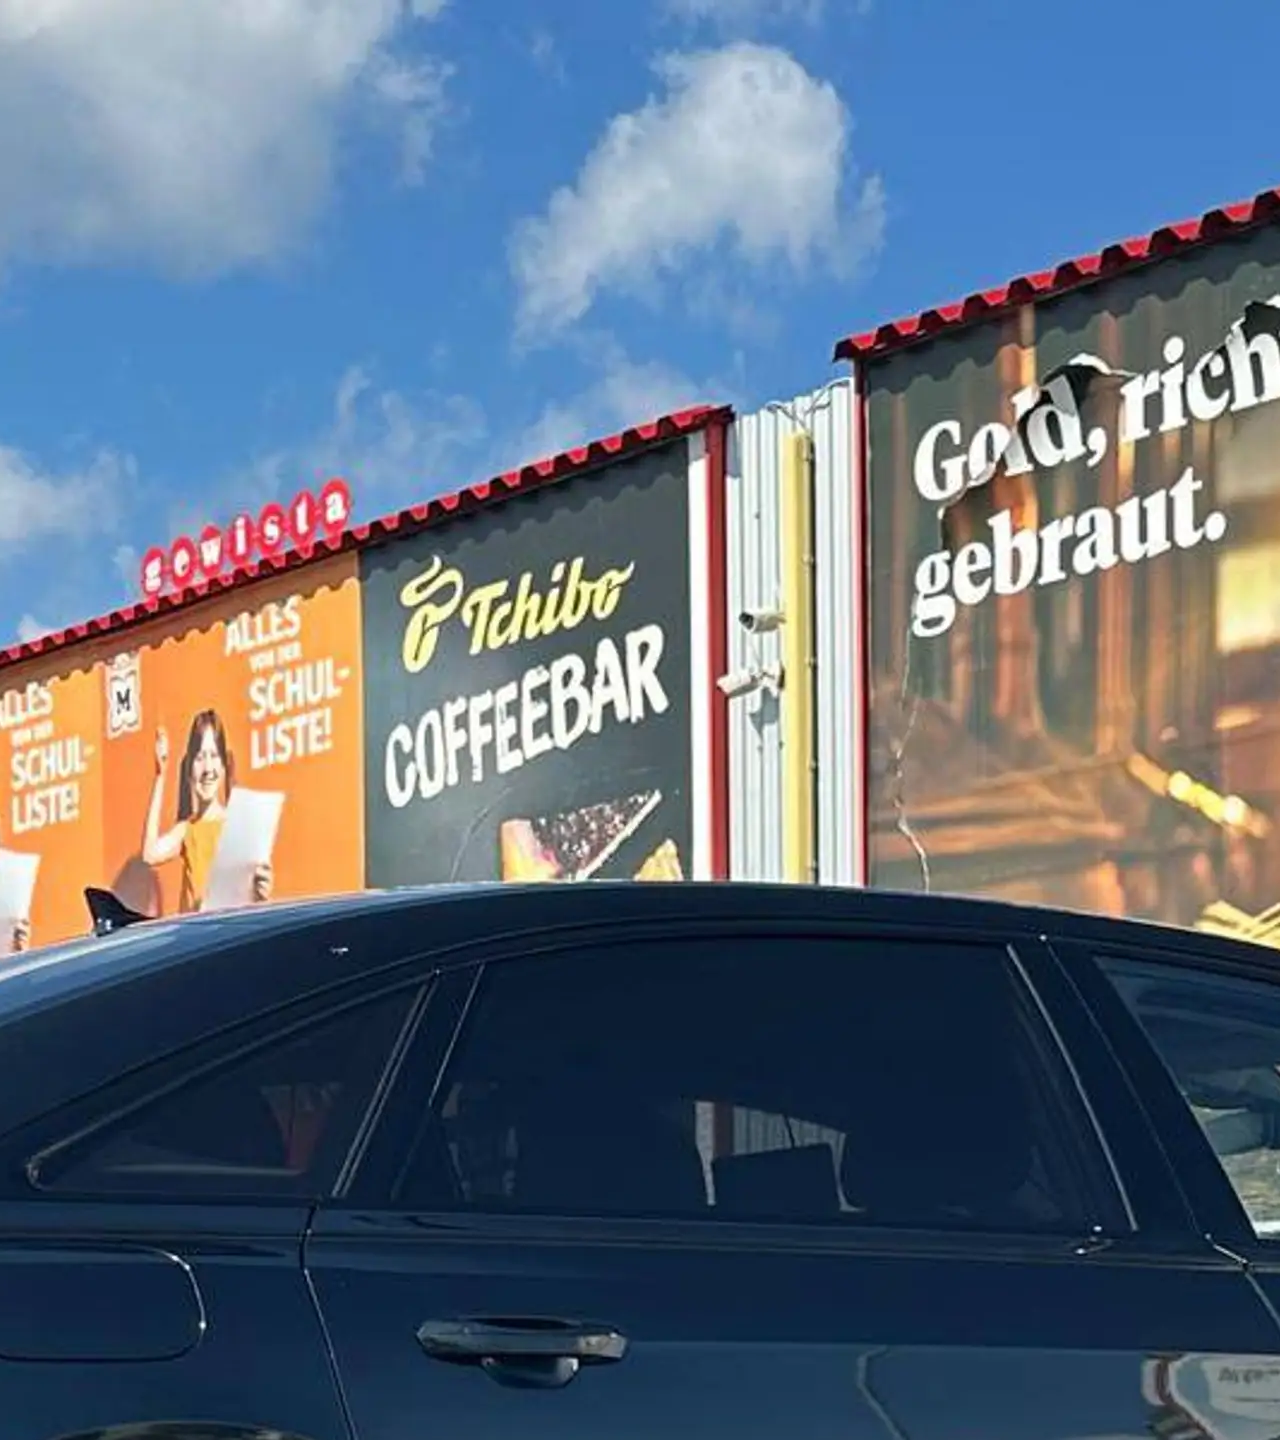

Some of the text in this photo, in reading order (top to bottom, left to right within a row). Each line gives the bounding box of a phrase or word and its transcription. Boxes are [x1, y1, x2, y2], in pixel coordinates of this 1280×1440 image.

[914, 374, 1107, 501] Gold,
[911, 466, 1228, 638] gebraut.
[225, 594, 301, 657] ALLES
[461, 557, 635, 655] Tchibo
[248, 657, 350, 722] SCHUL-
[385, 624, 670, 808] COFFEEBAR
[11, 735, 96, 792] SCHUL-
[251, 707, 333, 769] LISTE!
[12, 782, 80, 834] LISTE!
